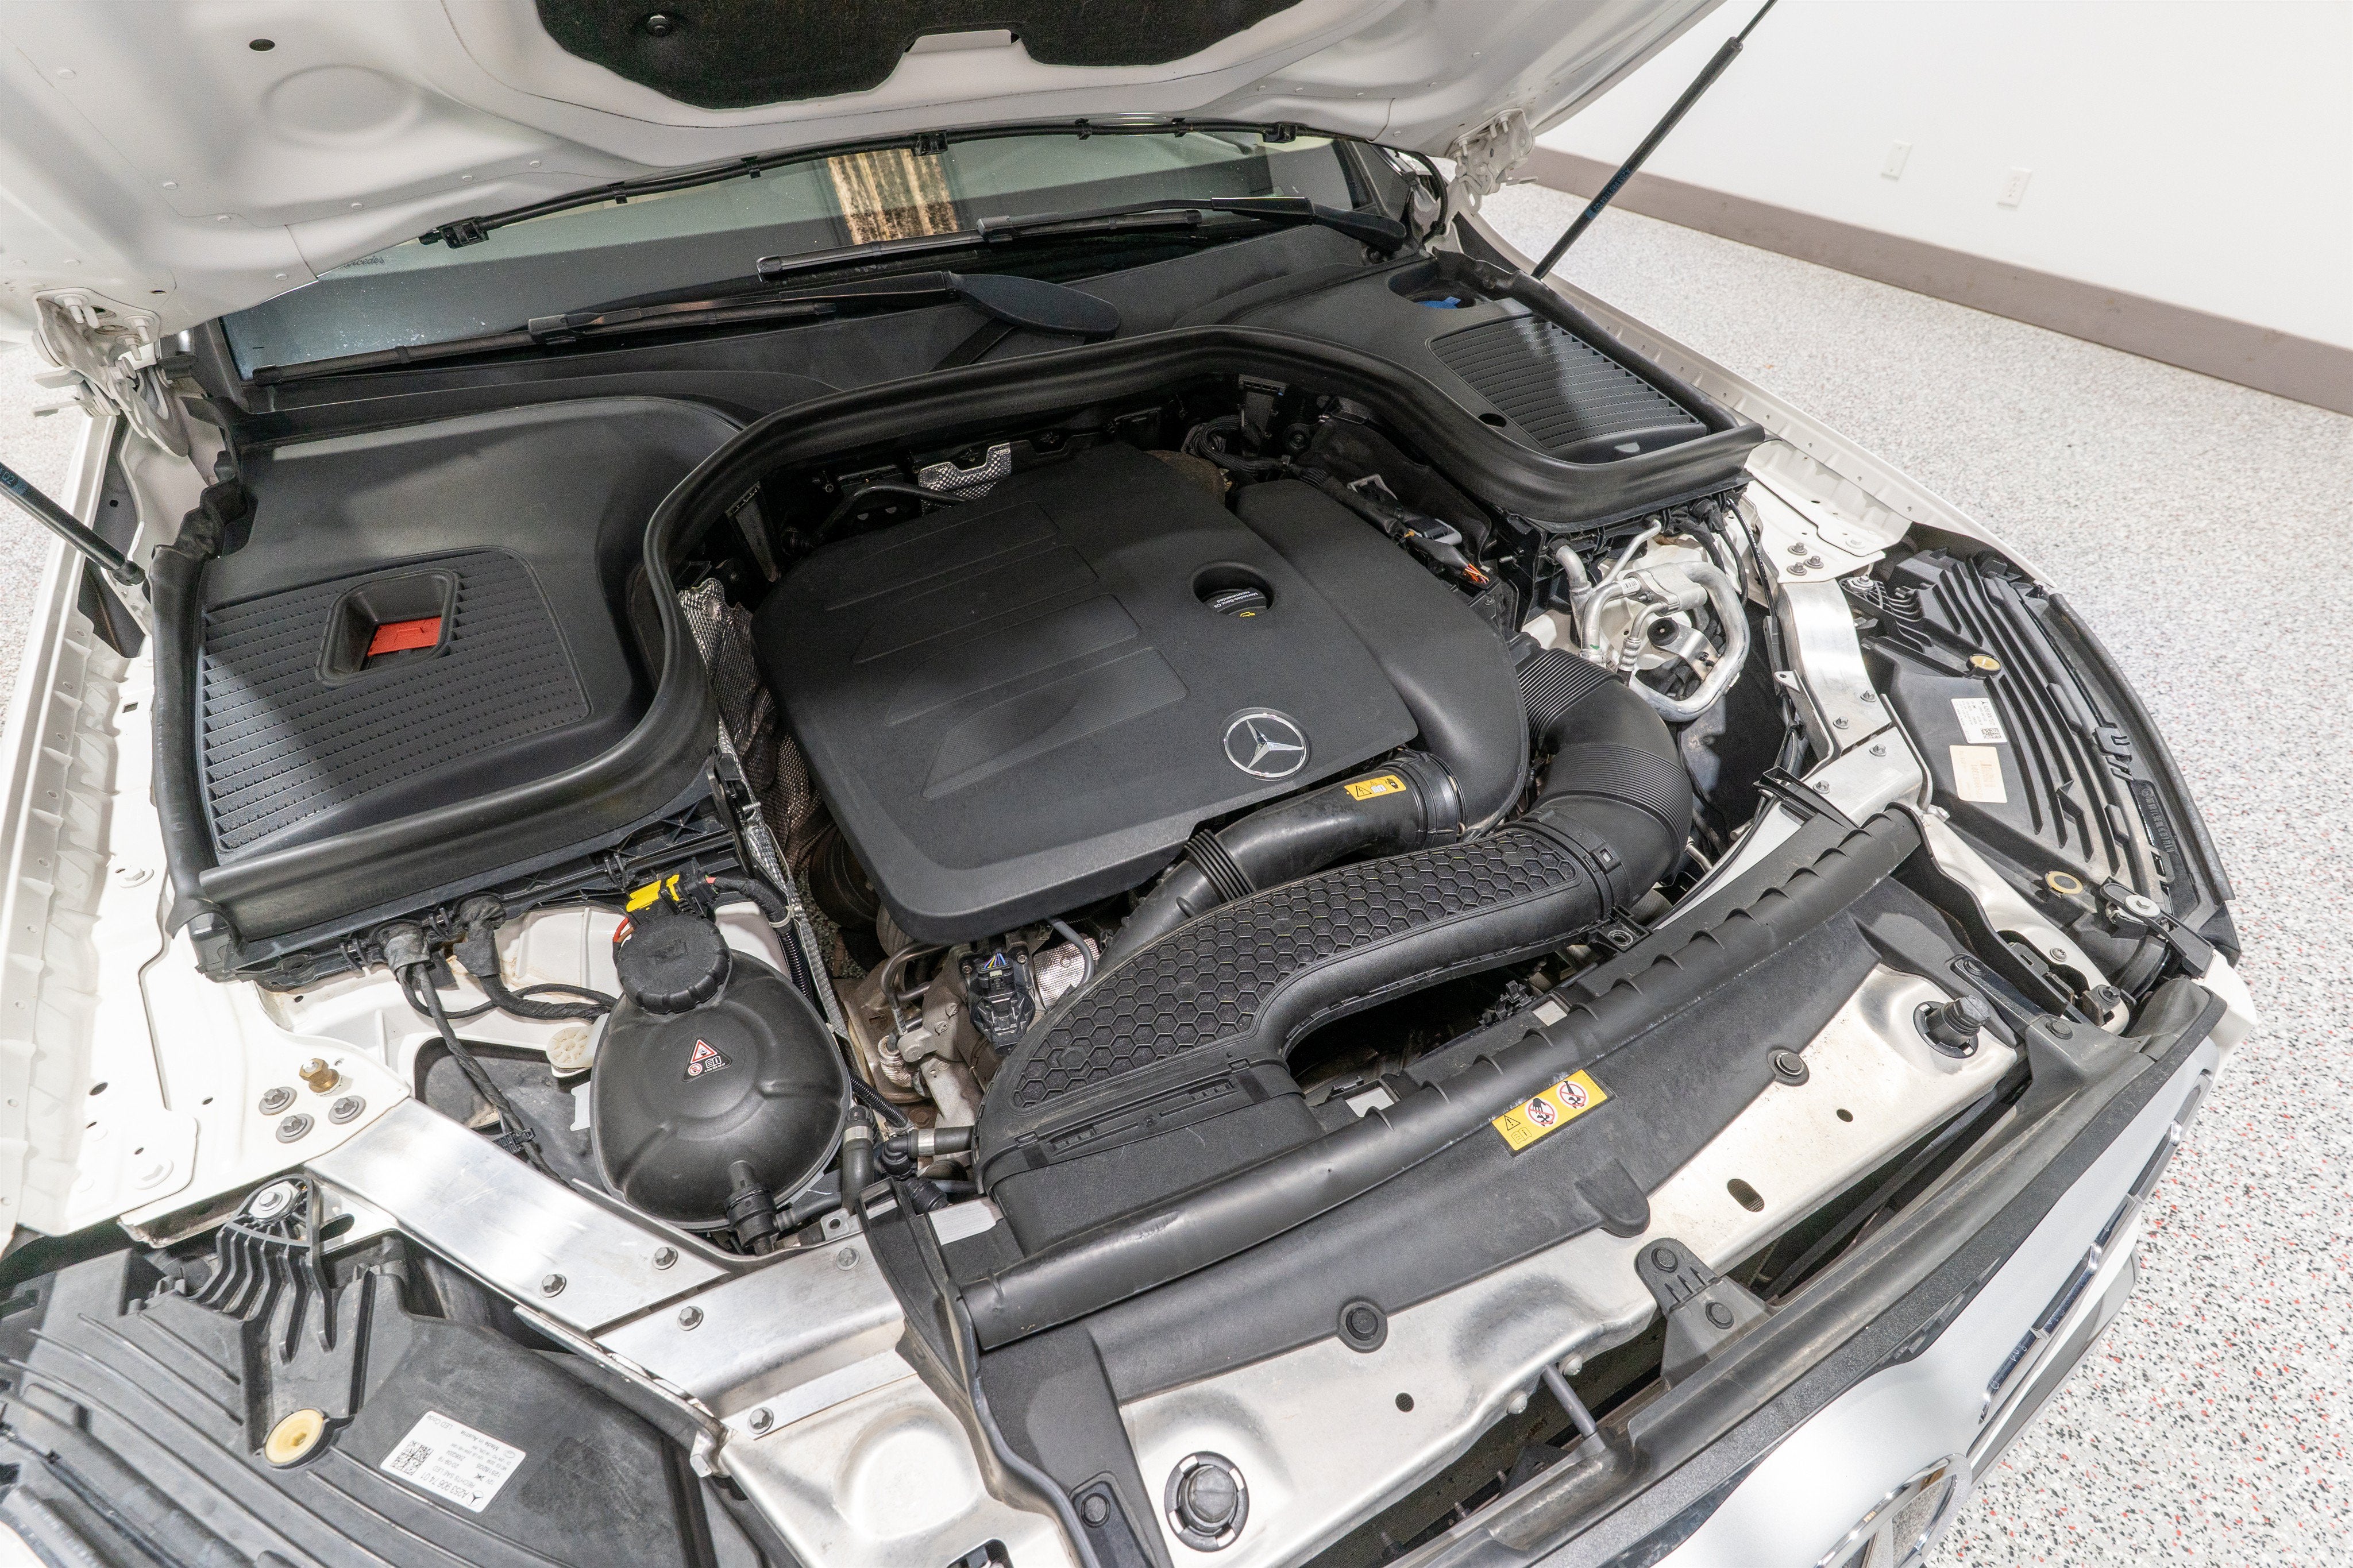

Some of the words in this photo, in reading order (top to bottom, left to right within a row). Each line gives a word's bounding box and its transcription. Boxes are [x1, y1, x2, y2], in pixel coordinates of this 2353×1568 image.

[1216, 590, 1251, 603] recommended
[1221, 592, 1258, 605] Mercedes-Benz
[427, 1415, 441, 1424] Code
[440, 1421, 453, 1430] LED
[460, 1430, 477, 1441] Austria
[485, 1441, 499, 1451] Made
[443, 1470, 454, 1478] SAE
[429, 1476, 438, 1486] 74
[437, 1480, 452, 1490] 906
[454, 1475, 475, 1488] RECHTS
[450, 1485, 469, 1498] A253
